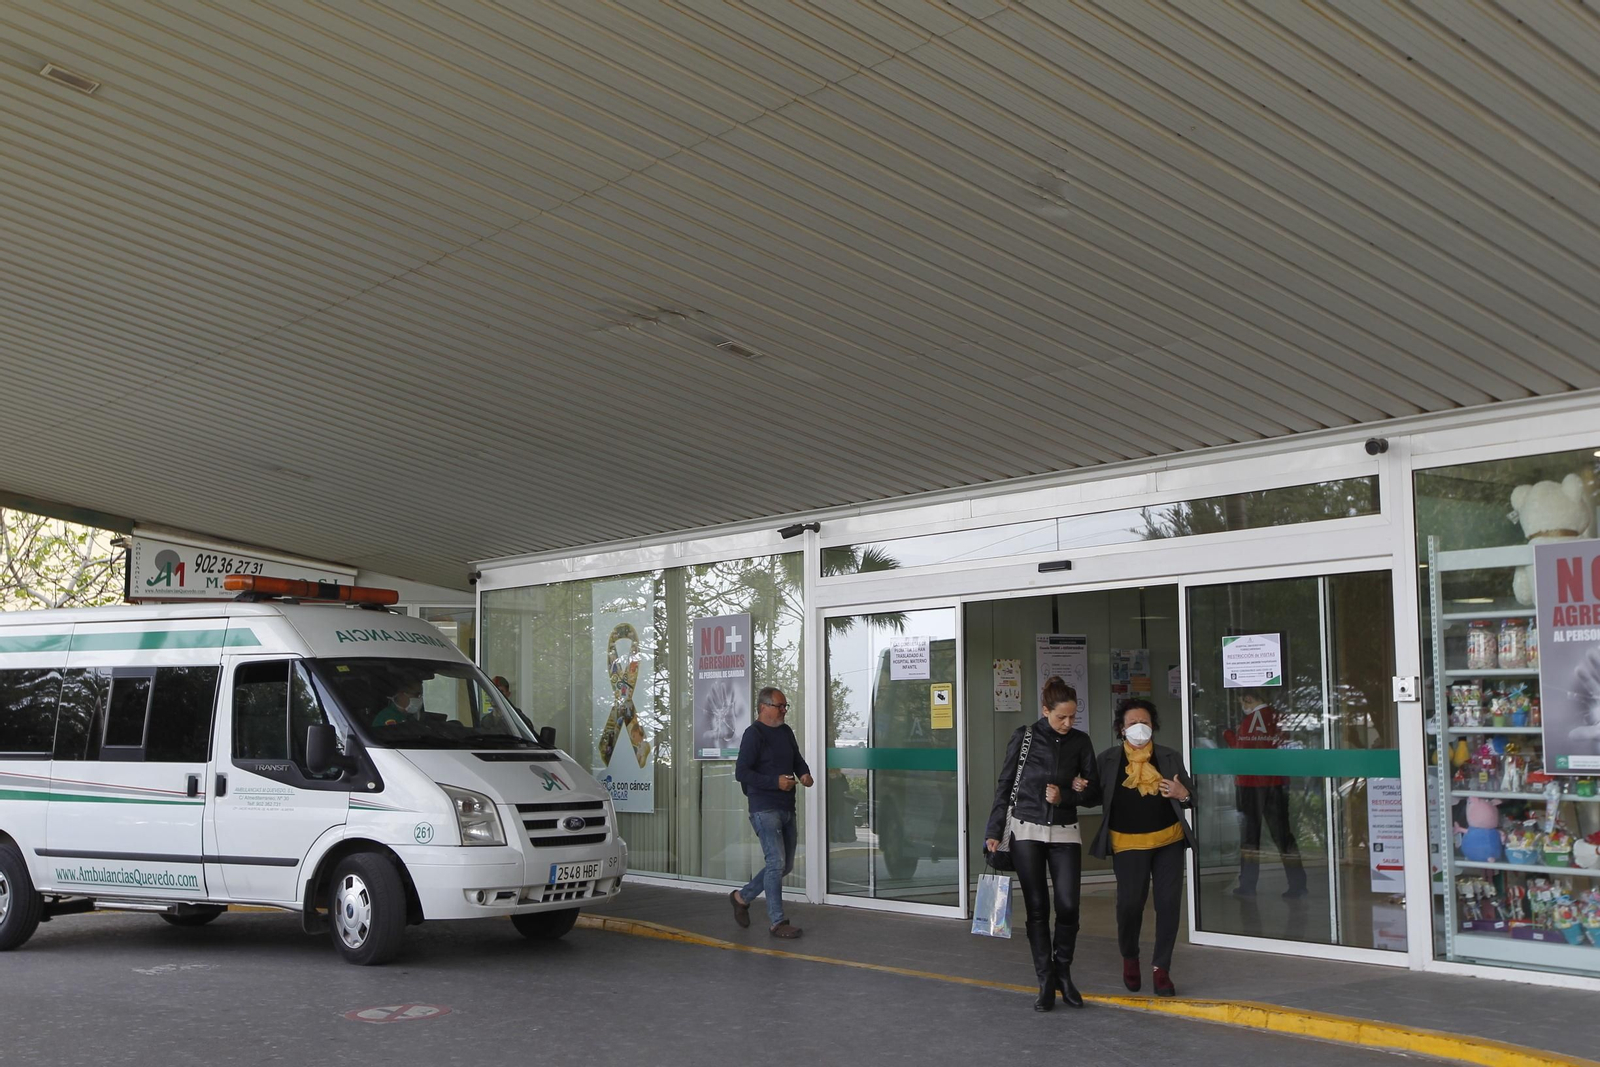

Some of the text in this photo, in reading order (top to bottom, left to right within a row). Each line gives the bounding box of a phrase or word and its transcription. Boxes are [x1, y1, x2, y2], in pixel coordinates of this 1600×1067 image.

[194, 554, 264, 575] 902 36 27 31
[1553, 630, 1565, 642] AL
[698, 654, 745, 670] AGRESIONES
[699, 669, 745, 680] AL PERSONAL DE SANIDAD
[617, 782, 628, 790] con
[630, 779, 651, 790] cáncer
[416, 826, 431, 839] 261
[55, 866, 199, 888] www.AmbulanciasQuevedo.com
[557, 863, 598, 881] 2548 HBF
